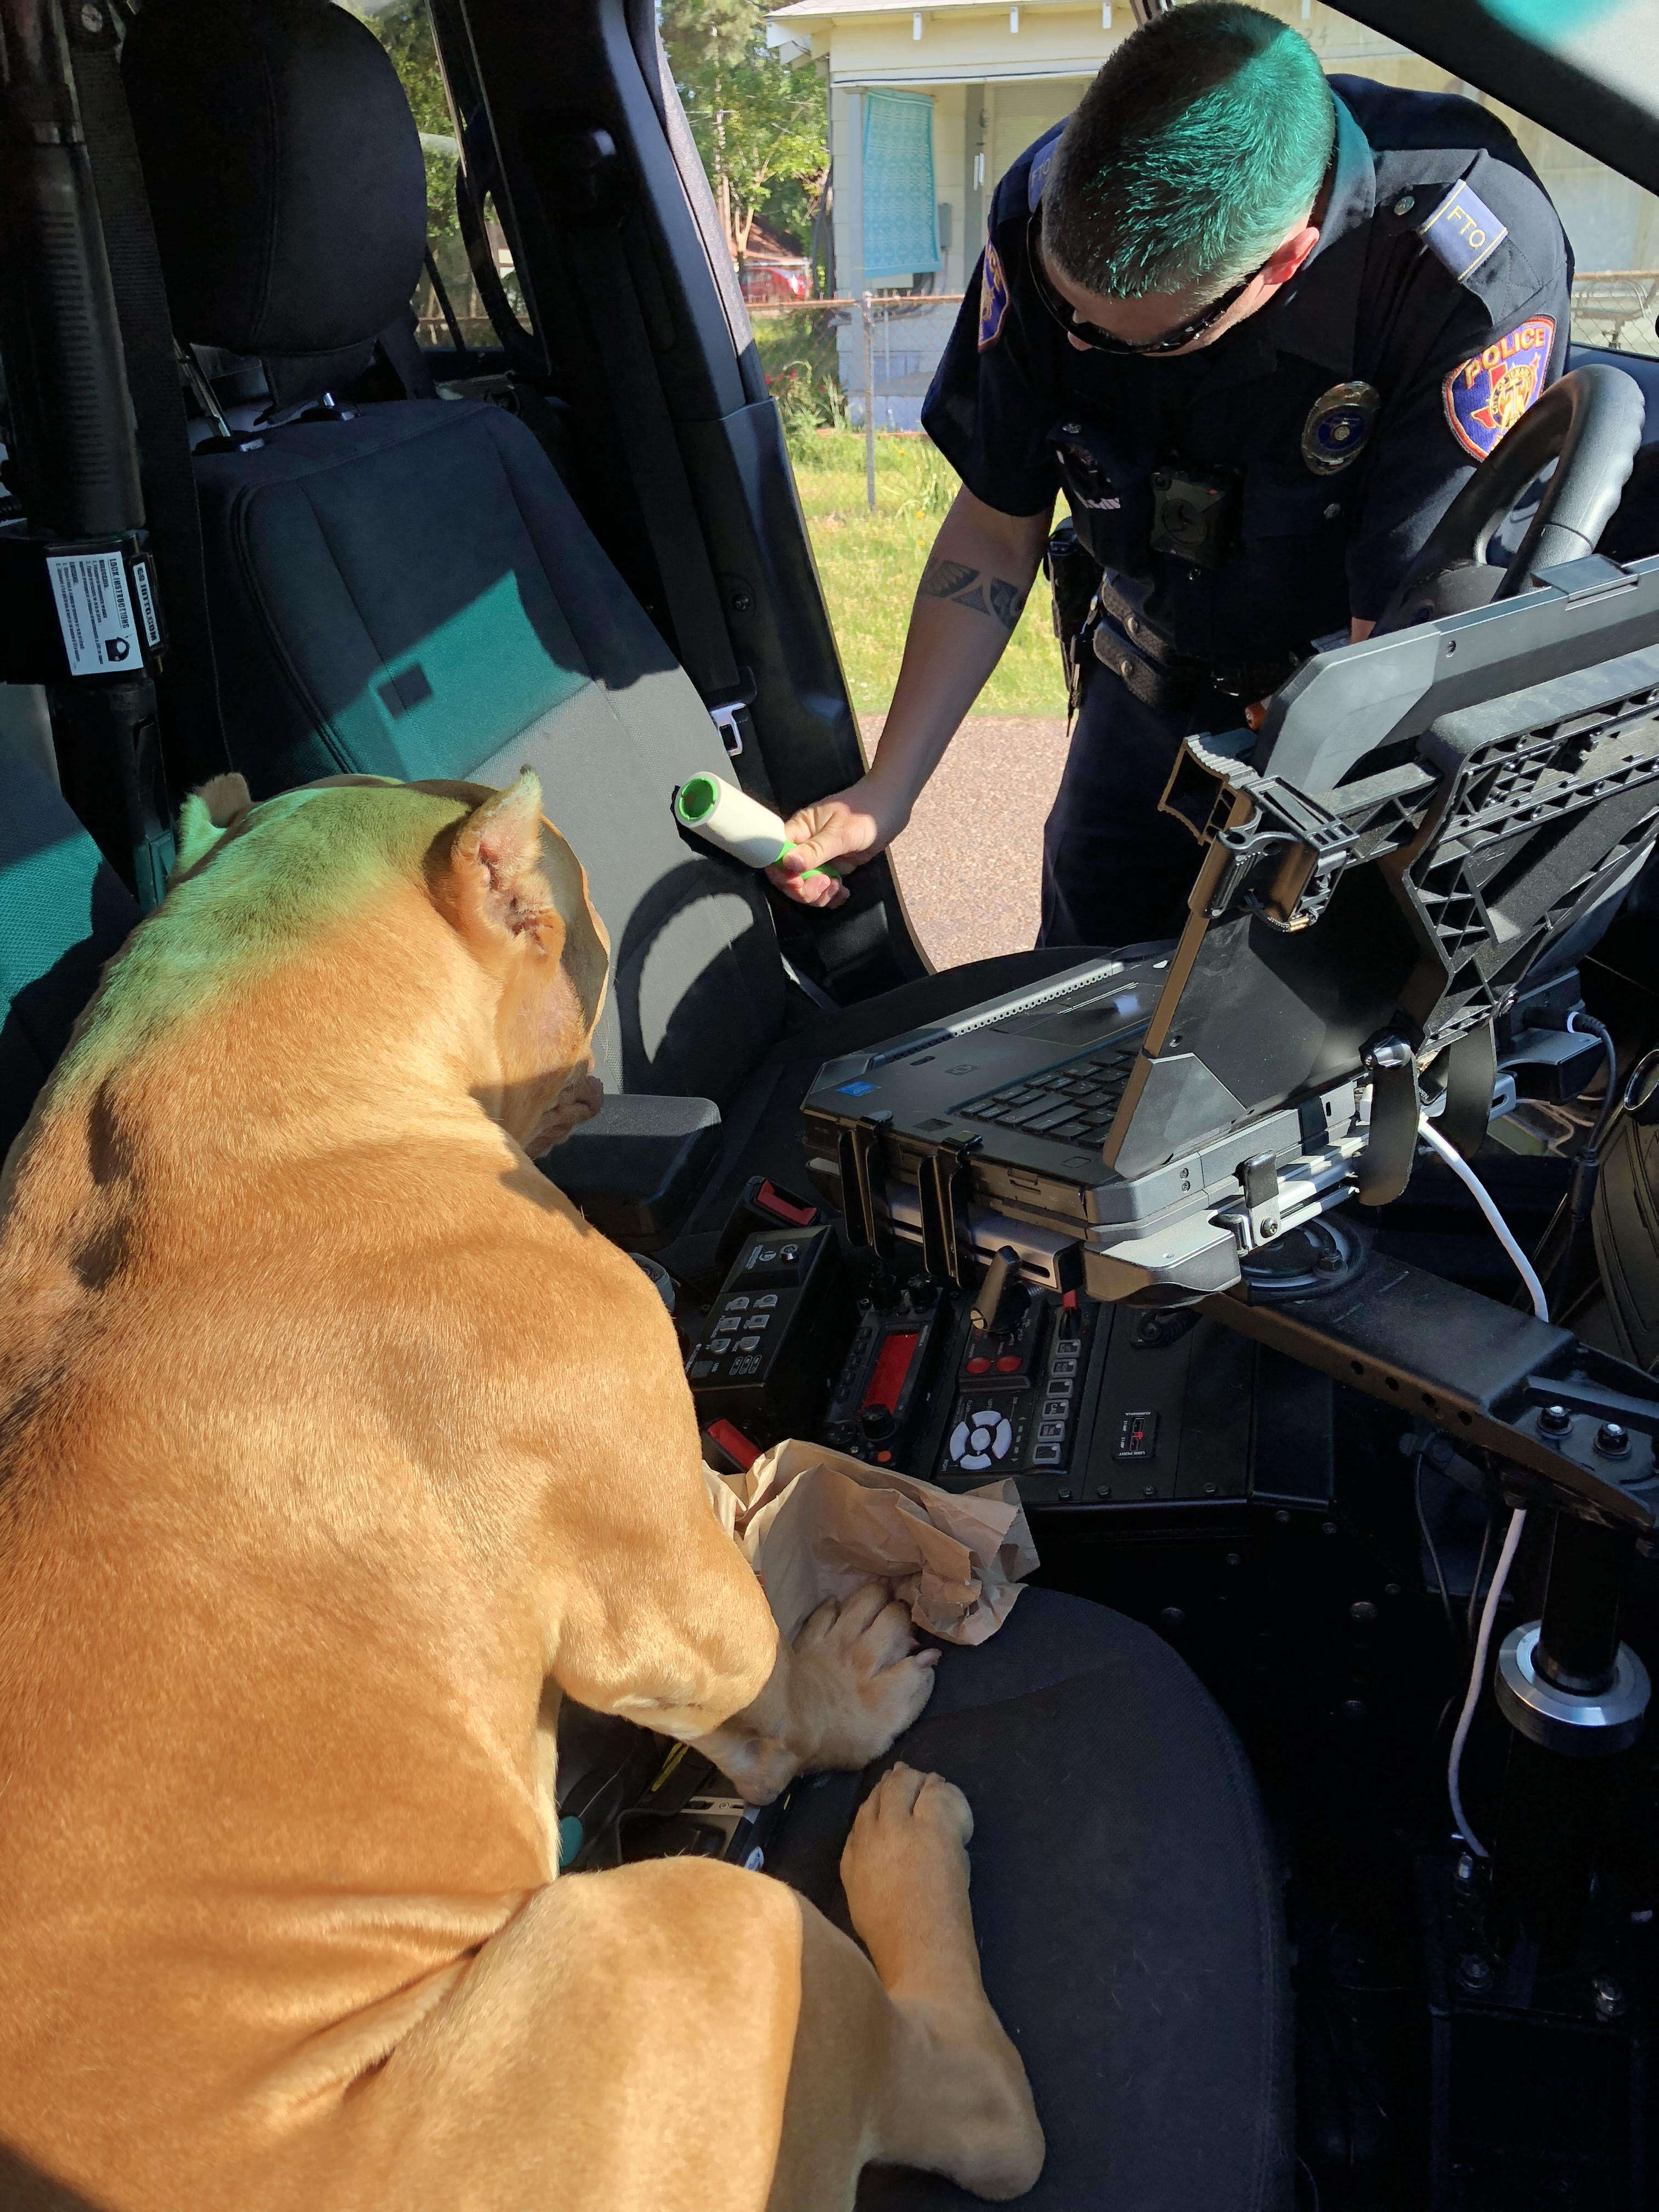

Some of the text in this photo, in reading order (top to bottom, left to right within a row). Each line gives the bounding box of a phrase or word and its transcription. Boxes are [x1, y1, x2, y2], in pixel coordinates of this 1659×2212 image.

[1447, 205, 1486, 250] FTO
[1464, 328, 1546, 390] POLICE
[110, 558, 130, 629] LOCK INSTRUCTIONS
